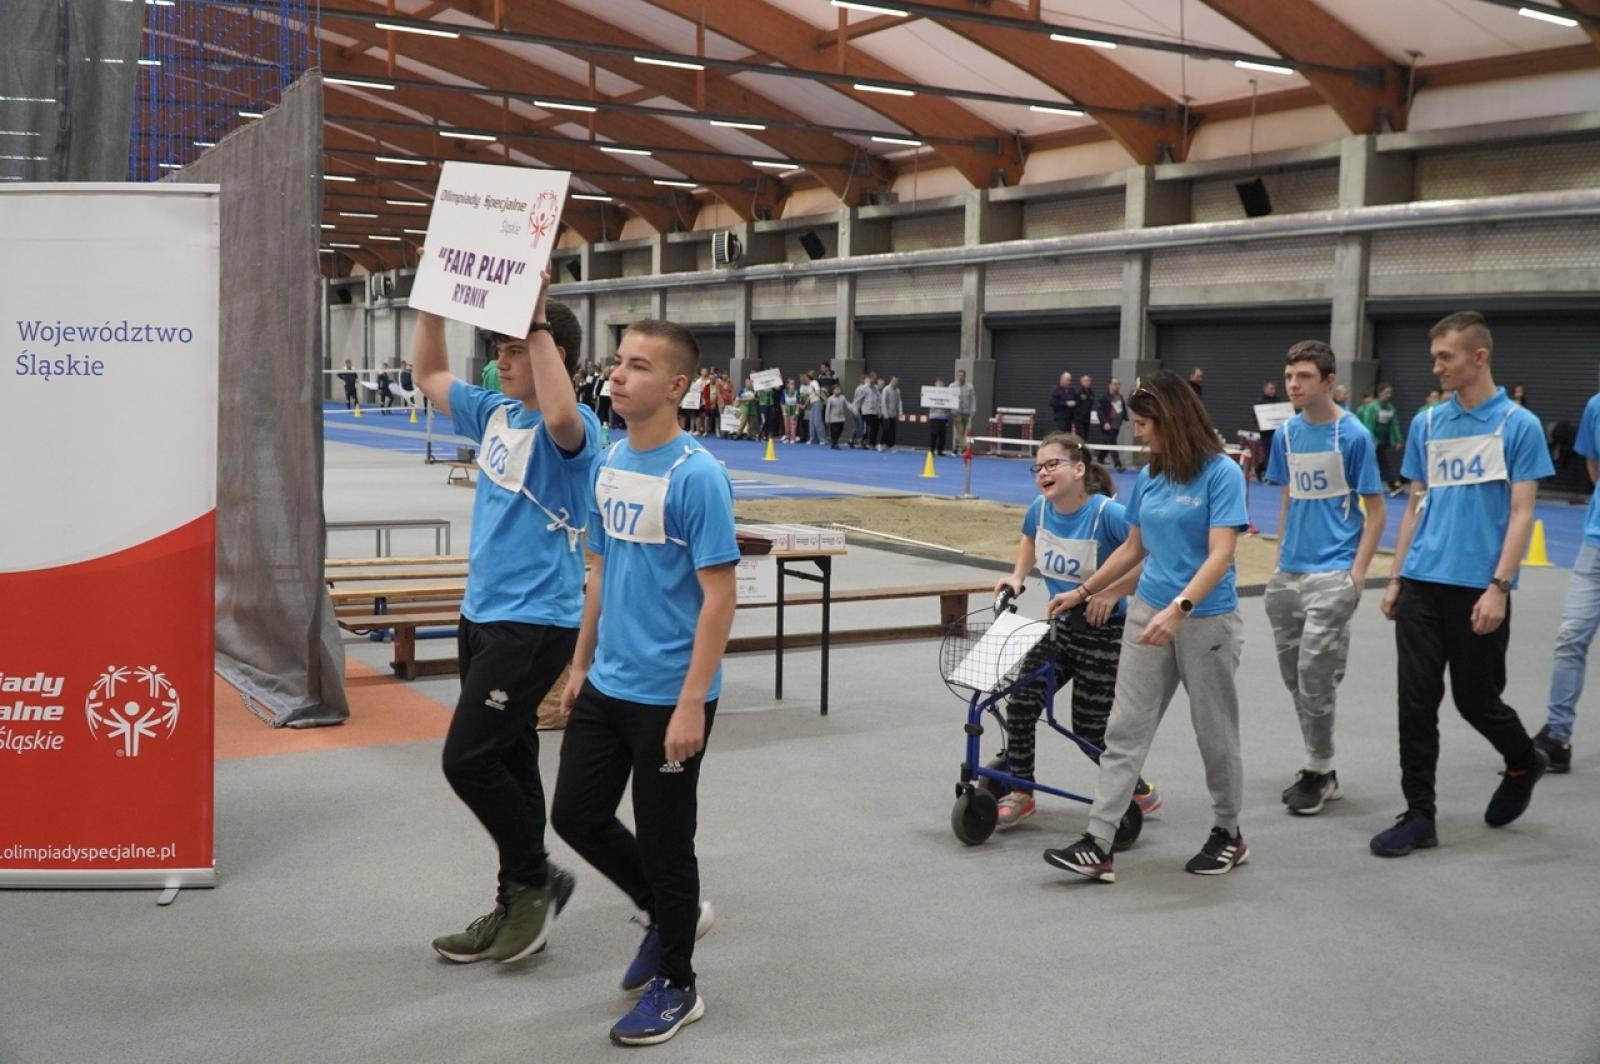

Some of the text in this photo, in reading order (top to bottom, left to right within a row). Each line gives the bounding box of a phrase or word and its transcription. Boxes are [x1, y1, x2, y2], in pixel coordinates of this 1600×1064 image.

[483, 194, 527, 212] Specjalne
[451, 283, 489, 310] RYBNIK
[16, 320, 193, 347] Województwo
[15, 350, 105, 381] Śląskie
[1294, 469, 1329, 492] 105
[1437, 454, 1485, 481] 104
[603, 497, 645, 535] 107
[1043, 549, 1081, 578] 102
